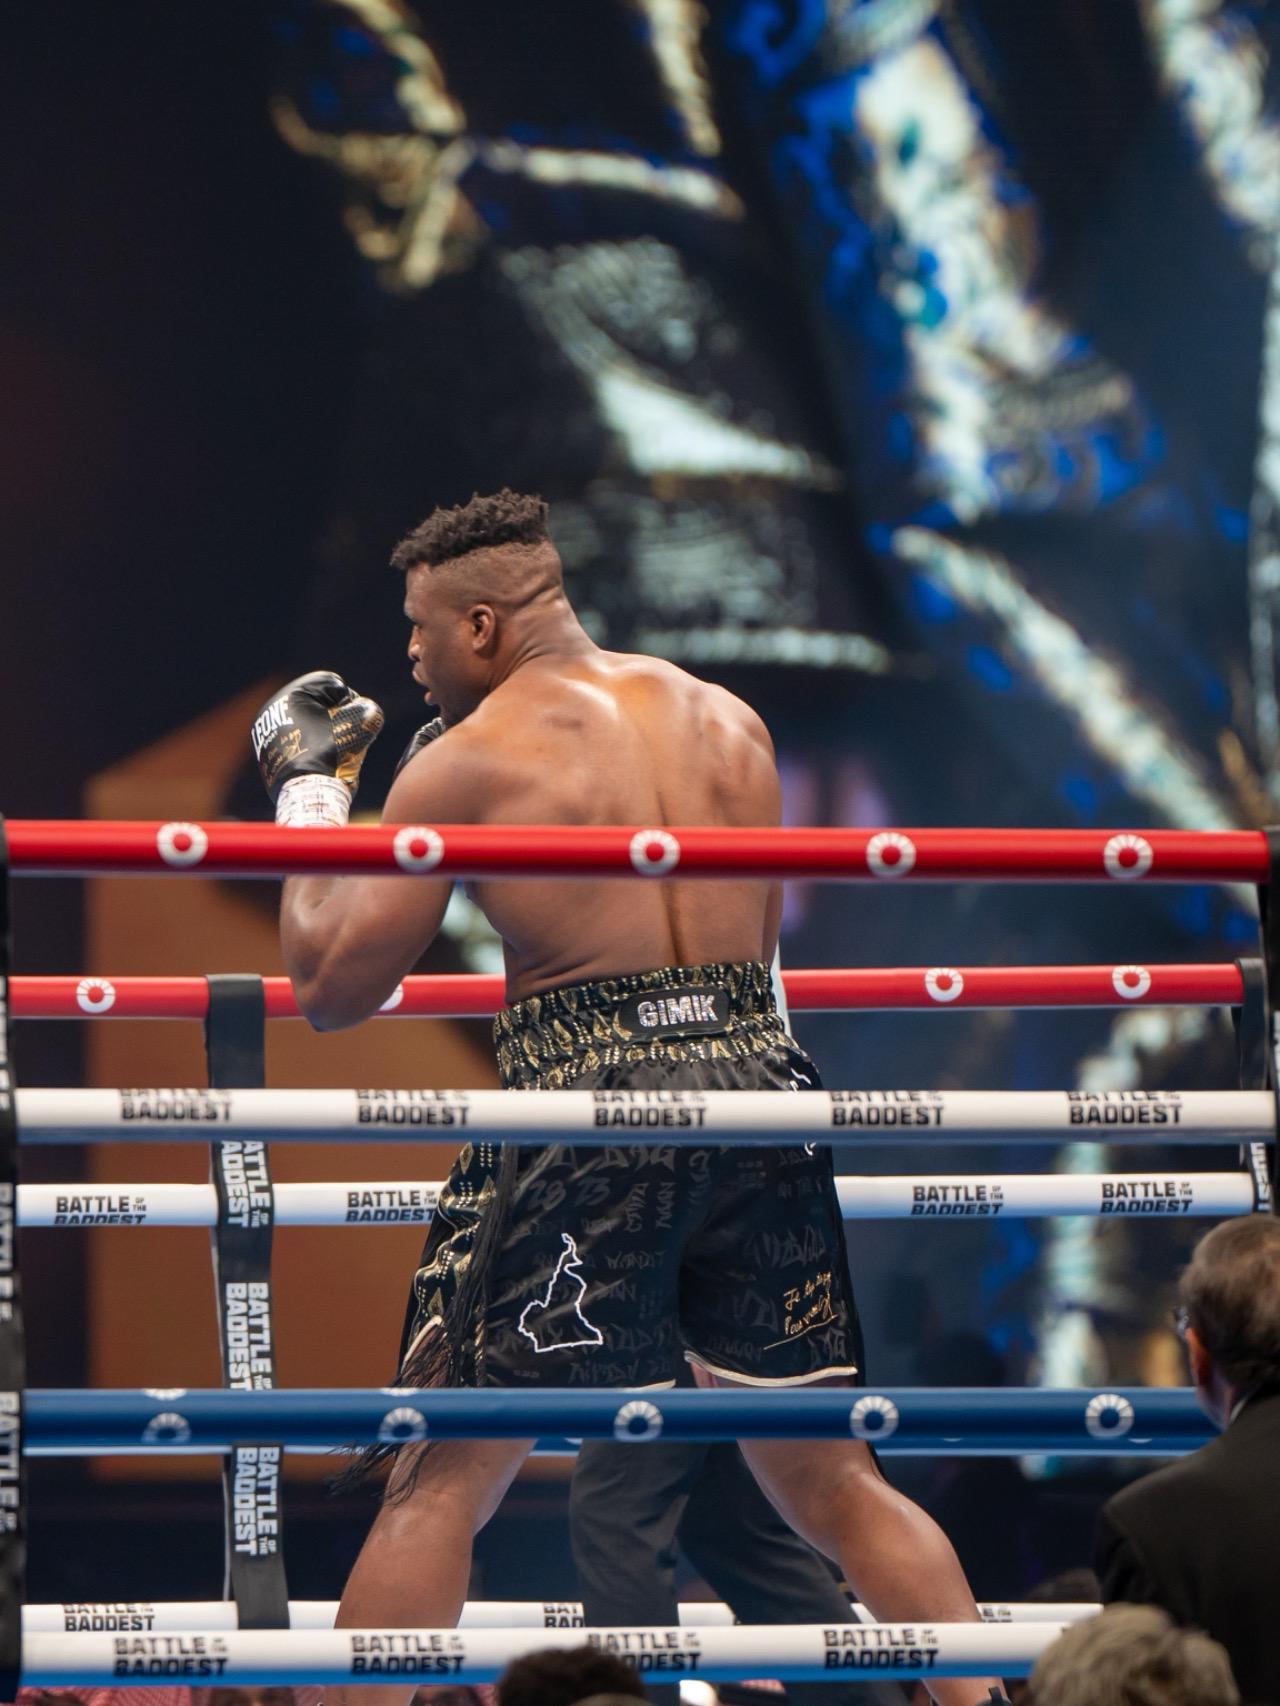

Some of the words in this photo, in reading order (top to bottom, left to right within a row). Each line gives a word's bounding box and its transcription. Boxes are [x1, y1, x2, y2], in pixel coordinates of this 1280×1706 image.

[251, 695, 294, 762] LEONE
[638, 995, 718, 1027] GIMIK
[122, 1102, 232, 1120] BADDEST
[358, 1106, 469, 1124] BADDEST
[593, 1107, 706, 1127] BADDEST
[831, 1107, 943, 1126] BADDEST
[1070, 1104, 1182, 1124] BADDEST
[221, 1141, 249, 1227] ADDEST
[243, 1141, 270, 1208] ATTLE
[347, 1191, 420, 1207] BATTLE
[913, 1184, 986, 1201] BATTLE
[1102, 1182, 1175, 1198] BATTLE
[56, 1196, 130, 1213] BATTLE
[910, 1204, 1003, 1216] BADDEST
[1100, 1200, 1192, 1213] BADDEST
[345, 1208, 435, 1222] BADDEST
[226, 1282, 253, 1391] BADDEST
[248, 1282, 272, 1373] BATTLE
[257, 1446, 280, 1535] BATTLE
[234, 1446, 258, 1556] BADDEST
[64, 1616, 155, 1631] BADDEST
[113, 1637, 205, 1656] BATTLE
[351, 1634, 442, 1654] BATTLE
[823, 1628, 916, 1648] BATTLE
[113, 1657, 228, 1677] BADDEST
[351, 1656, 464, 1675] BADDEST
[620, 1652, 701, 1671] DDEST
[825, 1650, 939, 1669] BADDEST
